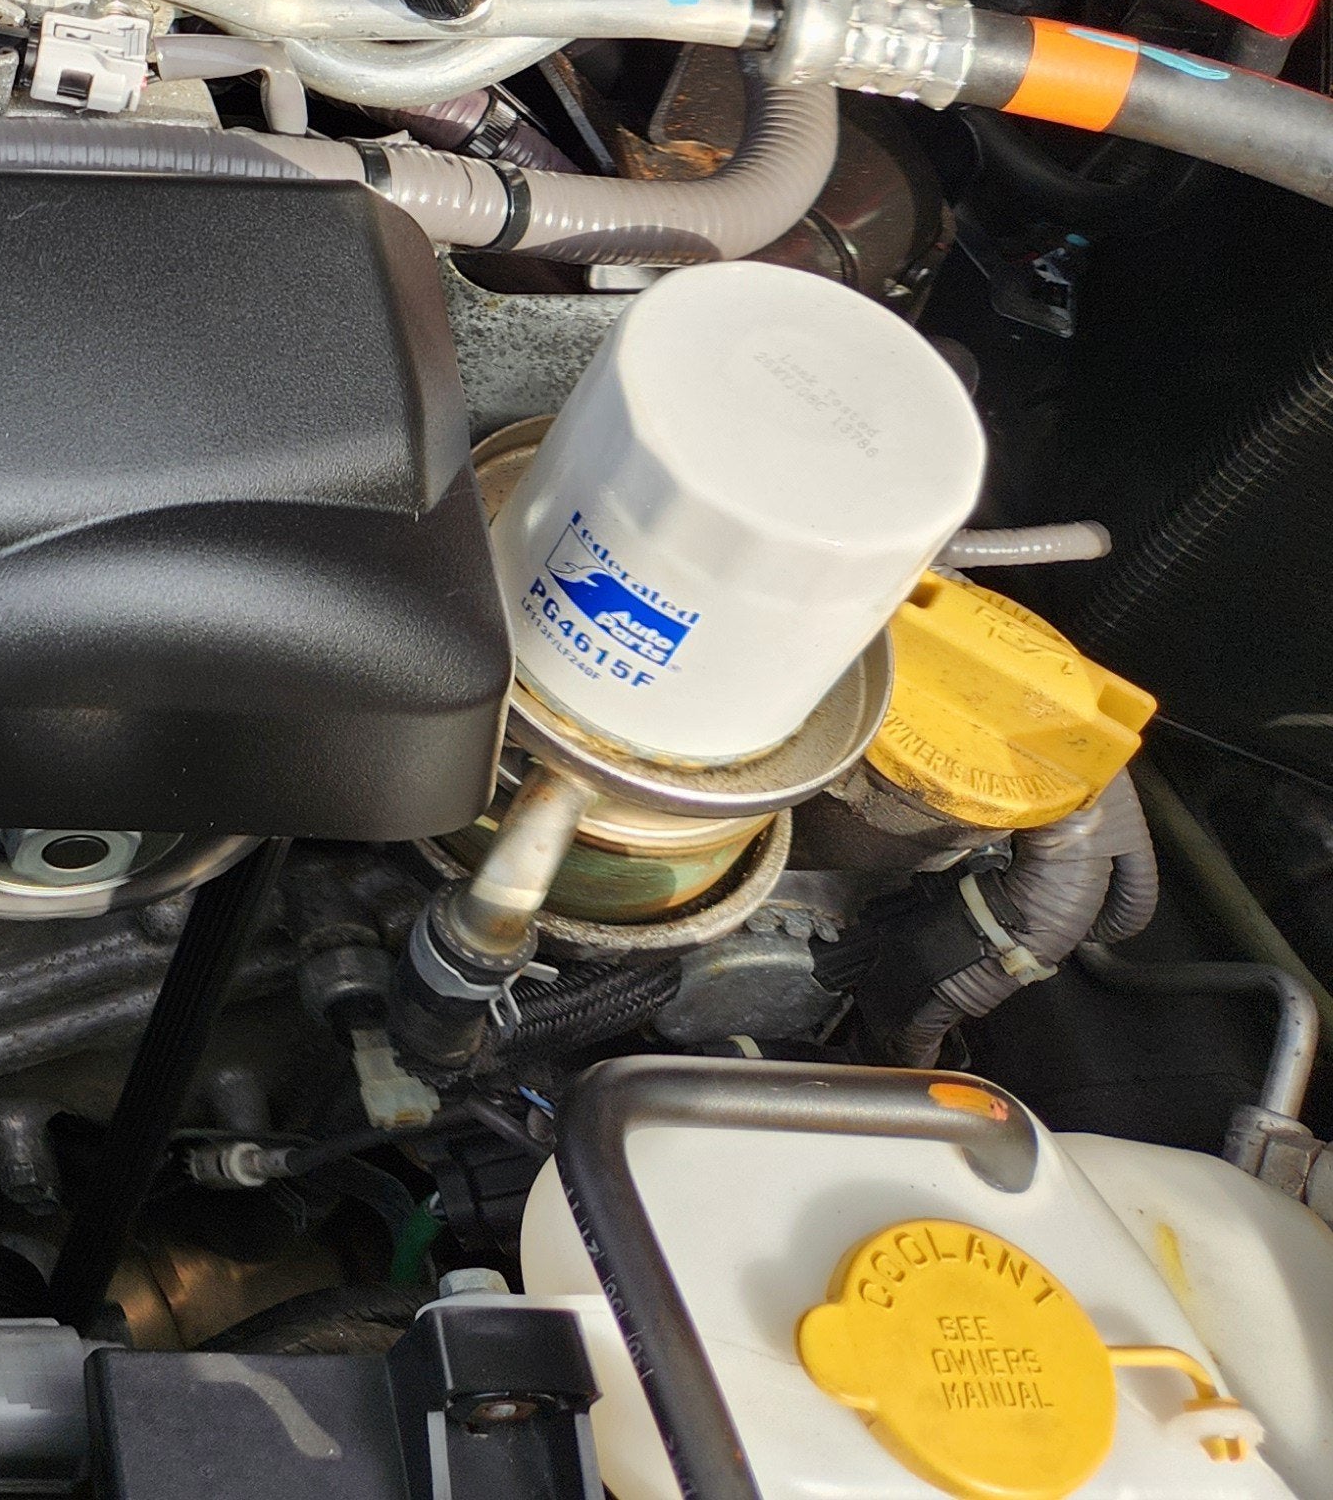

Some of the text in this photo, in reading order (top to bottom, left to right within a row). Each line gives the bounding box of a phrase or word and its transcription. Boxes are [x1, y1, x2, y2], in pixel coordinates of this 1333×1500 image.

[571, 510, 701, 626] Federated
[529, 576, 656, 688] PG4615F
[593, 611, 670, 666] Parts
[609, 610, 676, 652] Auto
[882, 713, 1067, 800] WNER'S MANUAL
[857, 1227, 1063, 1309] COOLANT
[935, 1315, 995, 1341] SEE
[931, 1348, 1042, 1376] OWNERS
[941, 1381, 1055, 1410] MANUAL
